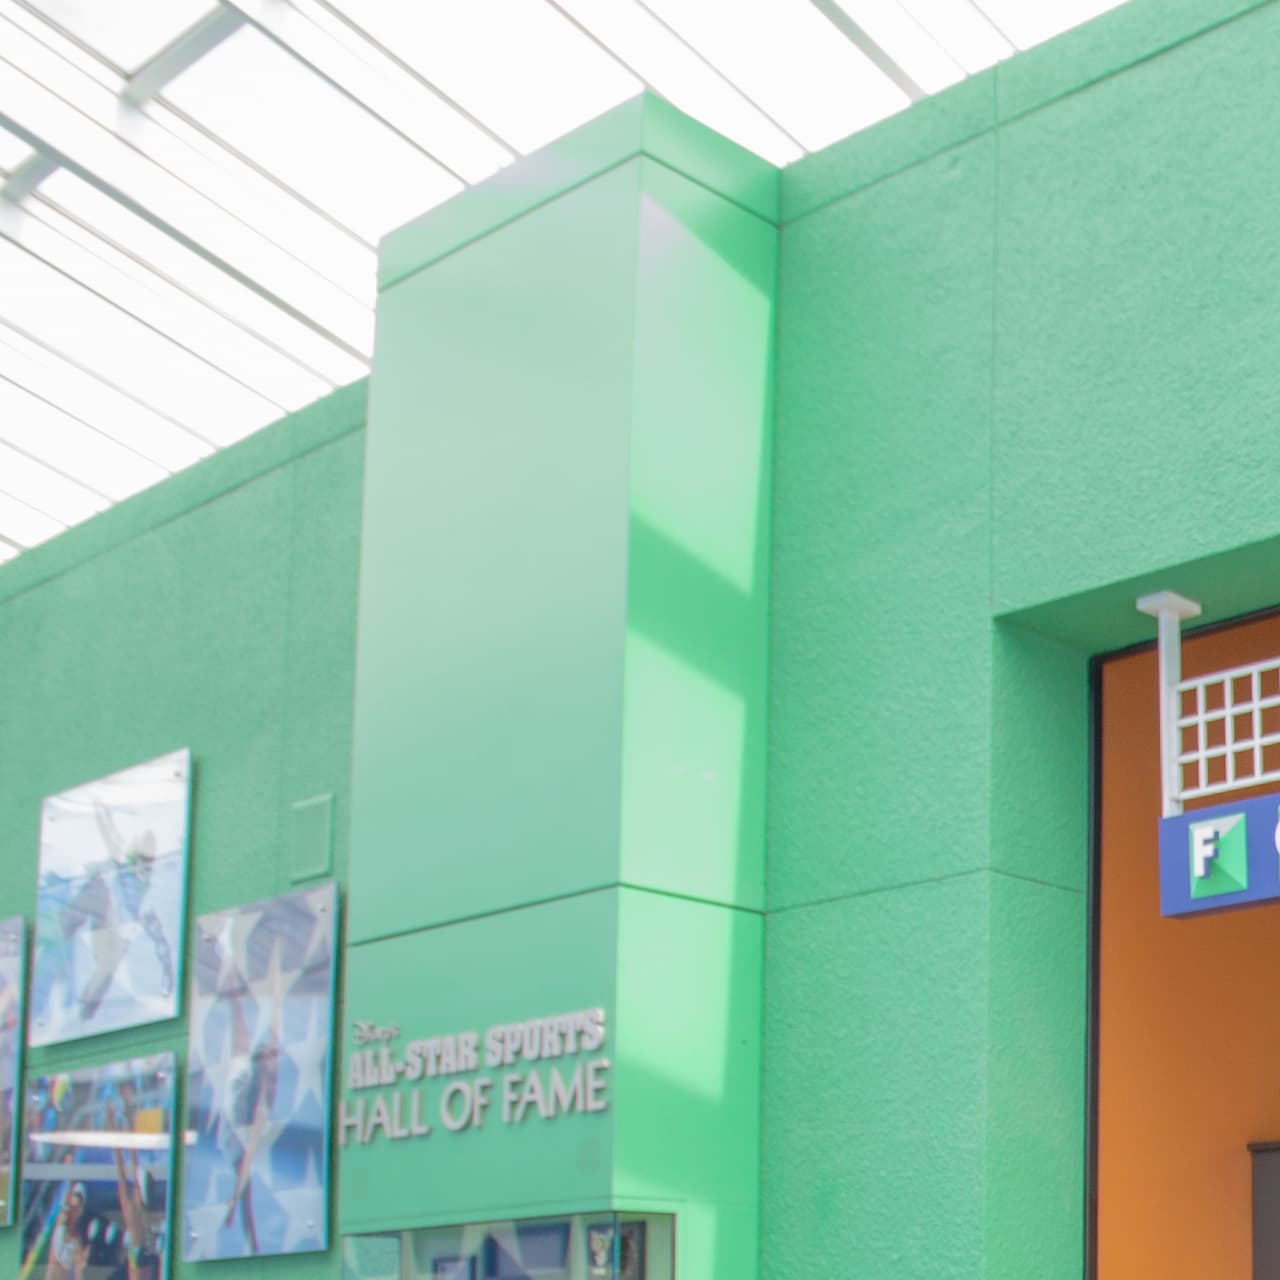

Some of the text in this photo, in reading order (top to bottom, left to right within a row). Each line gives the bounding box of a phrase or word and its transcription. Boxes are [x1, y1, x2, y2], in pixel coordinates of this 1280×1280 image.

[348, 1007, 606, 1090] ALL-STAR SPORTS
[338, 1058, 611, 1146] HALL OF FAME
